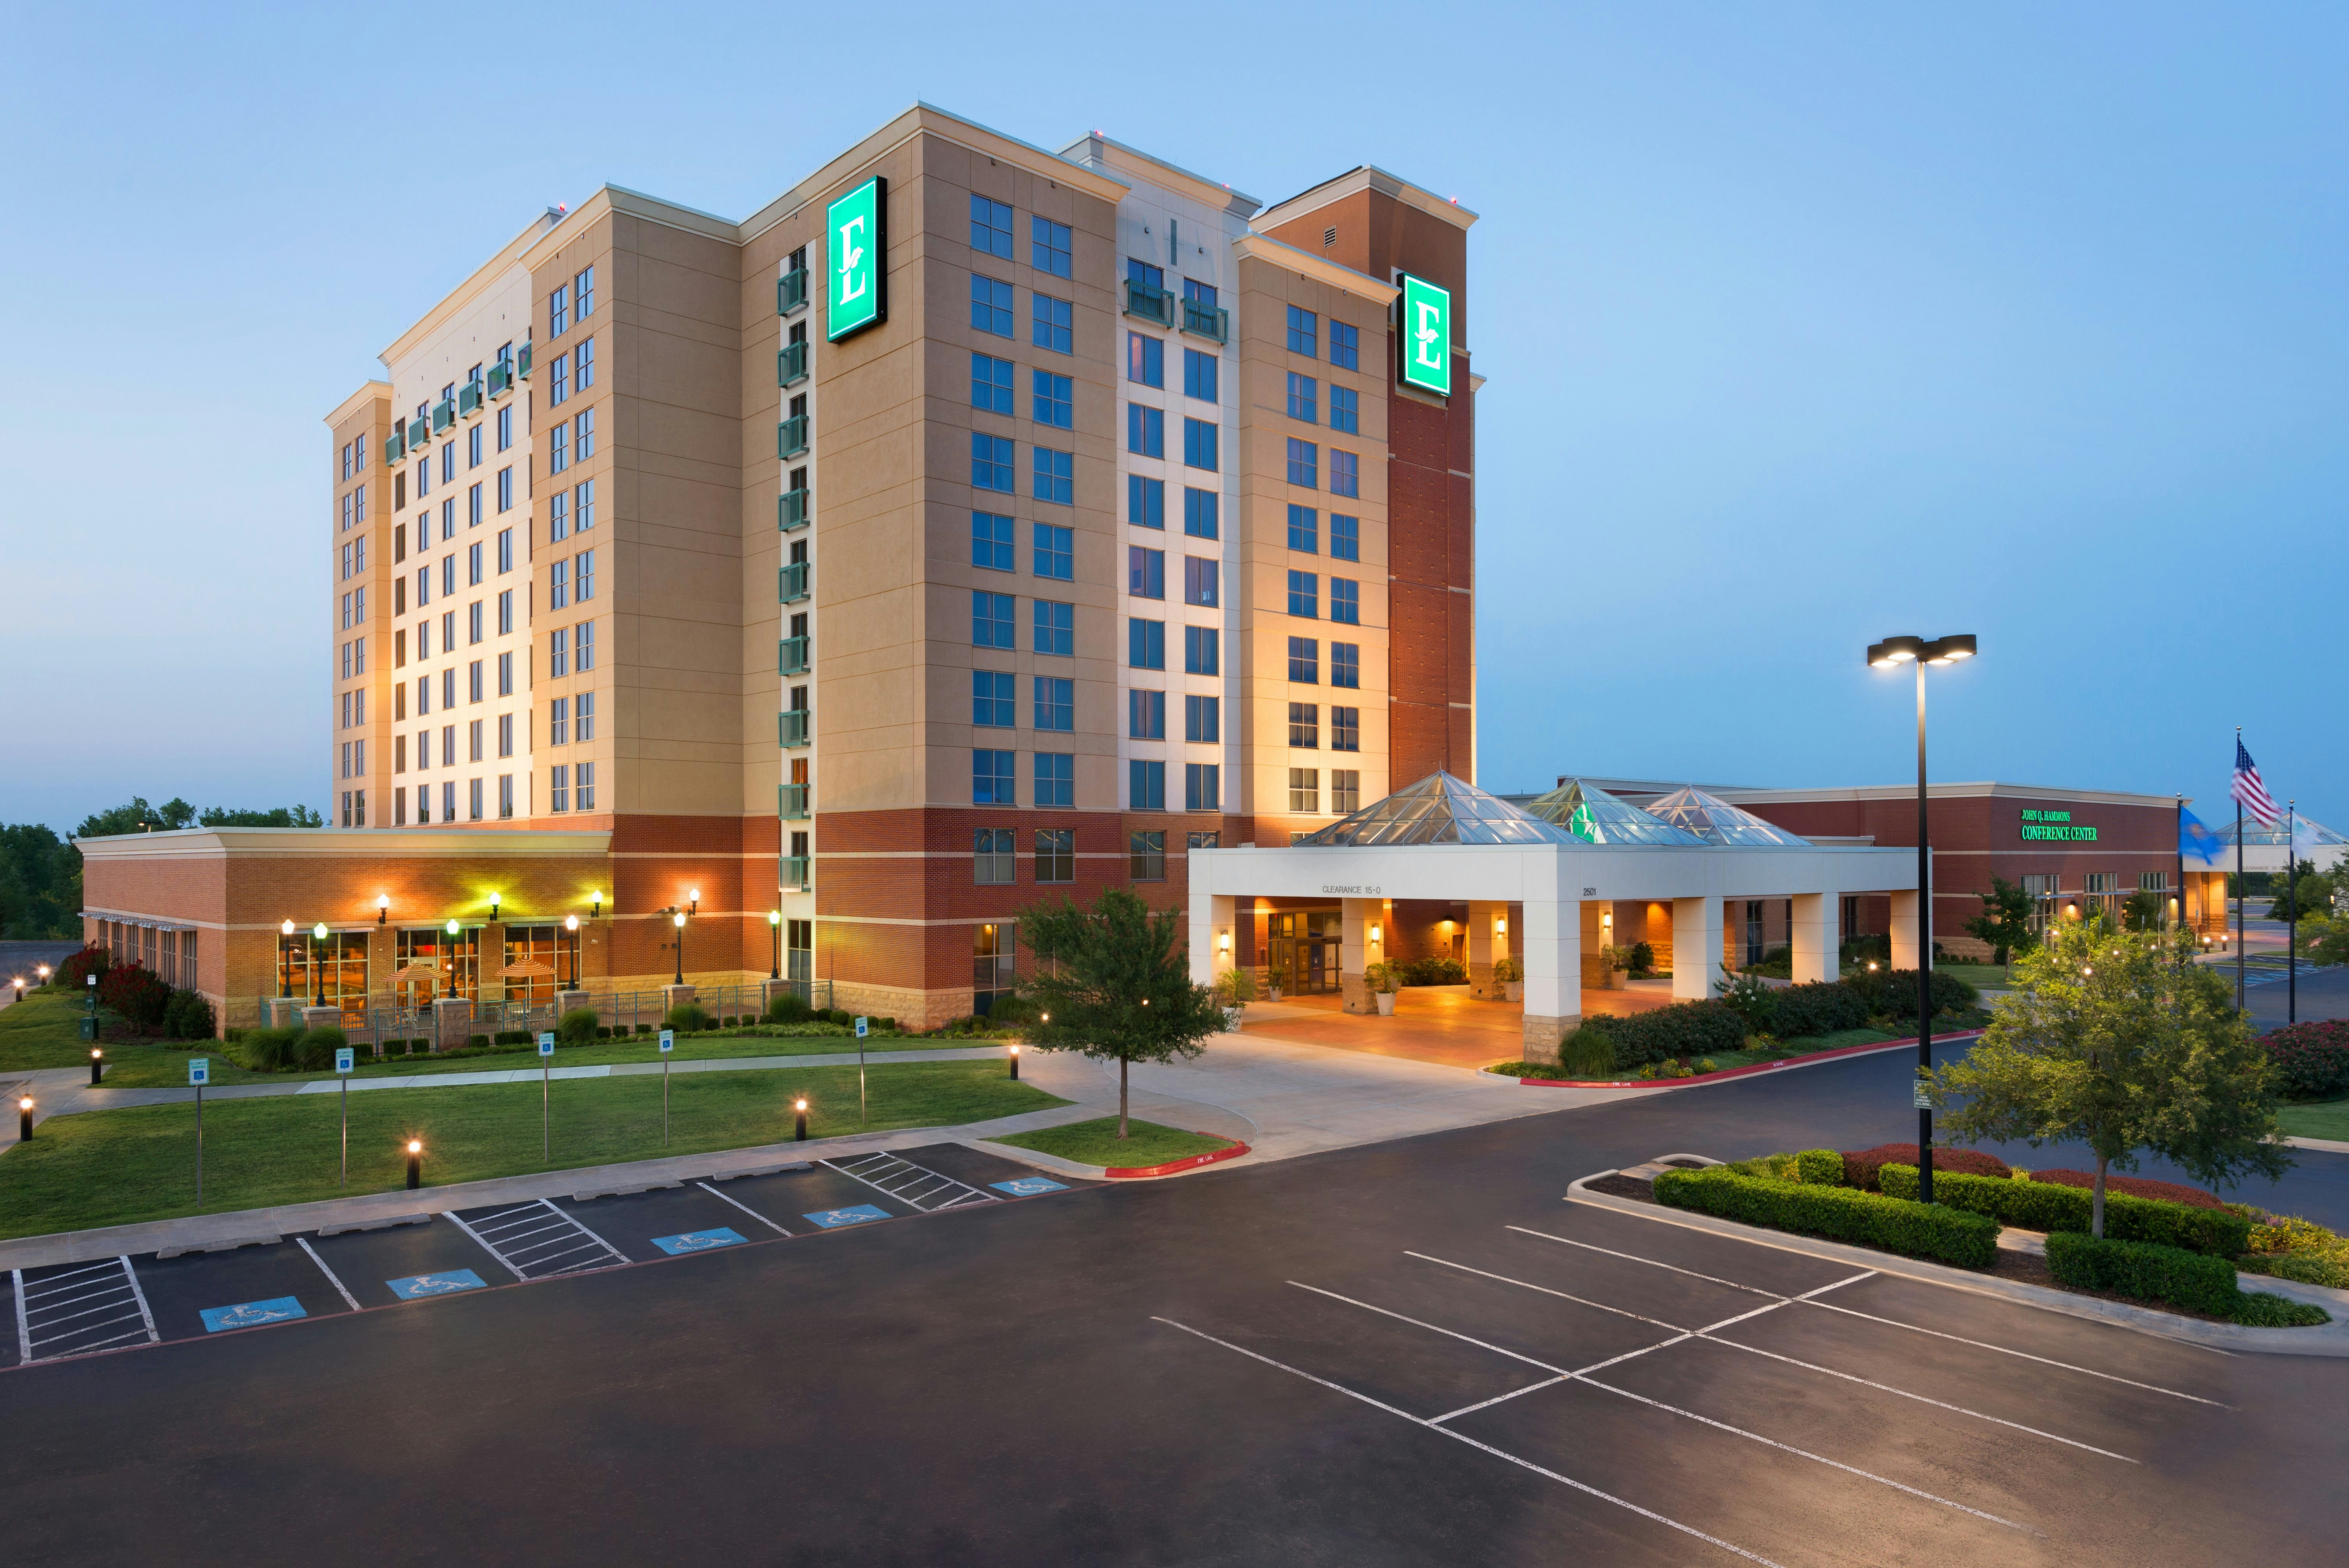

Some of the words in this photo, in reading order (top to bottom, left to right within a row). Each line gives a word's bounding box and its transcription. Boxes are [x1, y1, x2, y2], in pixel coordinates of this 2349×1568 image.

[2022, 810, 2037, 820] JOHN
[2038, 811, 2043, 823] Q.
[2044, 811, 2070, 821] HAMMONS
[2022, 825, 2069, 840] CONFERENCE
[2071, 827, 2097, 841] CENTER
[1583, 887, 1596, 896] 2501
